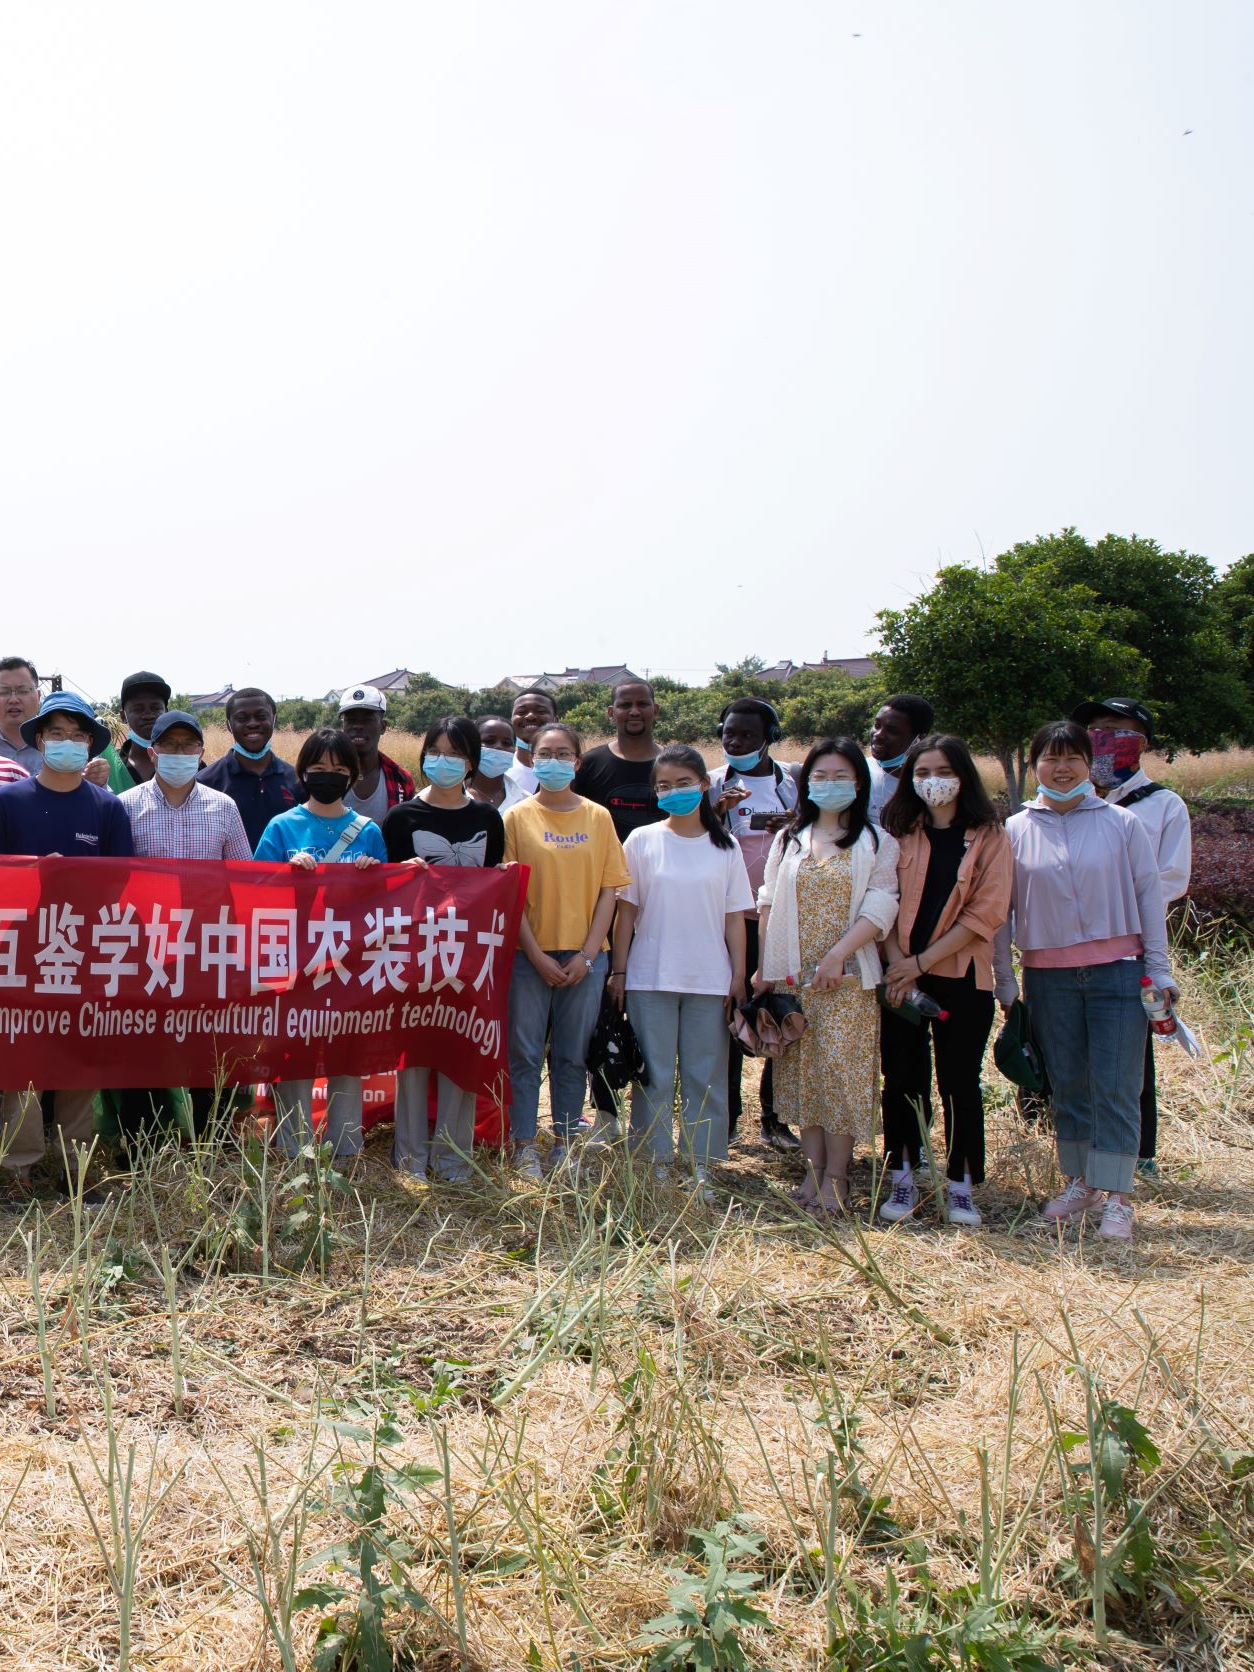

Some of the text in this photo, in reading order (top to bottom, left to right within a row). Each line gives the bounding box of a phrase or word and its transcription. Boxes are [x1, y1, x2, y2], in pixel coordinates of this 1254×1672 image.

[544, 831, 588, 844] Rouje
[79, 1001, 157, 1038] Chinese
[164, 996, 280, 1043] agricultural
[286, 998, 395, 1046] equipment
[401, 996, 501, 1060] technology
